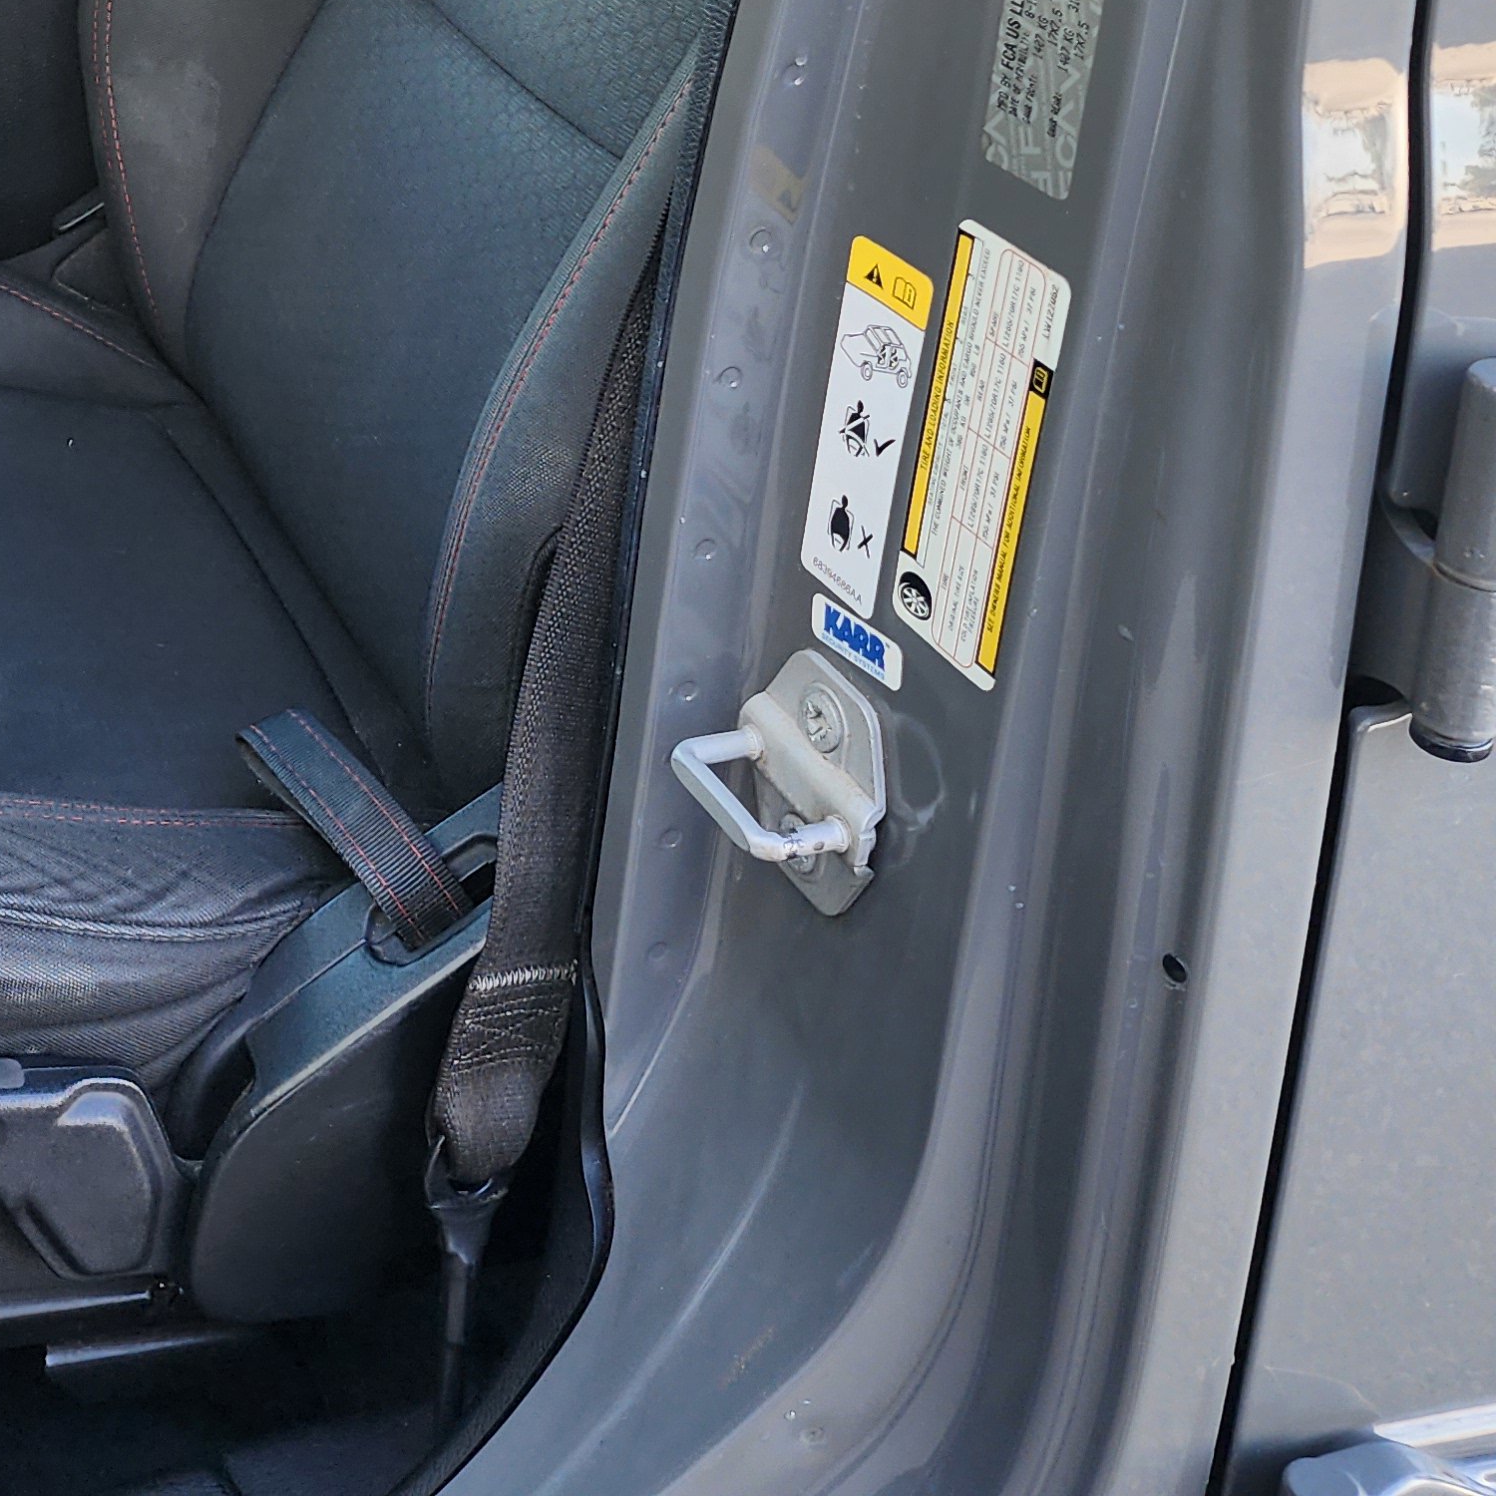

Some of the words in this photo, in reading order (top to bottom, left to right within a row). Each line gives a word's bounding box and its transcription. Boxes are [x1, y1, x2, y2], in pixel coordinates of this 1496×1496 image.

[1006, 17, 1020, 39] US
[1001, 40, 1017, 70] FCA
[936, 318, 953, 385] INFORMATION
[928, 385, 941, 427] LOADING
[924, 426, 933, 448] AND
[920, 448, 930, 472] TIRE
[824, 603, 886, 672] KARR
